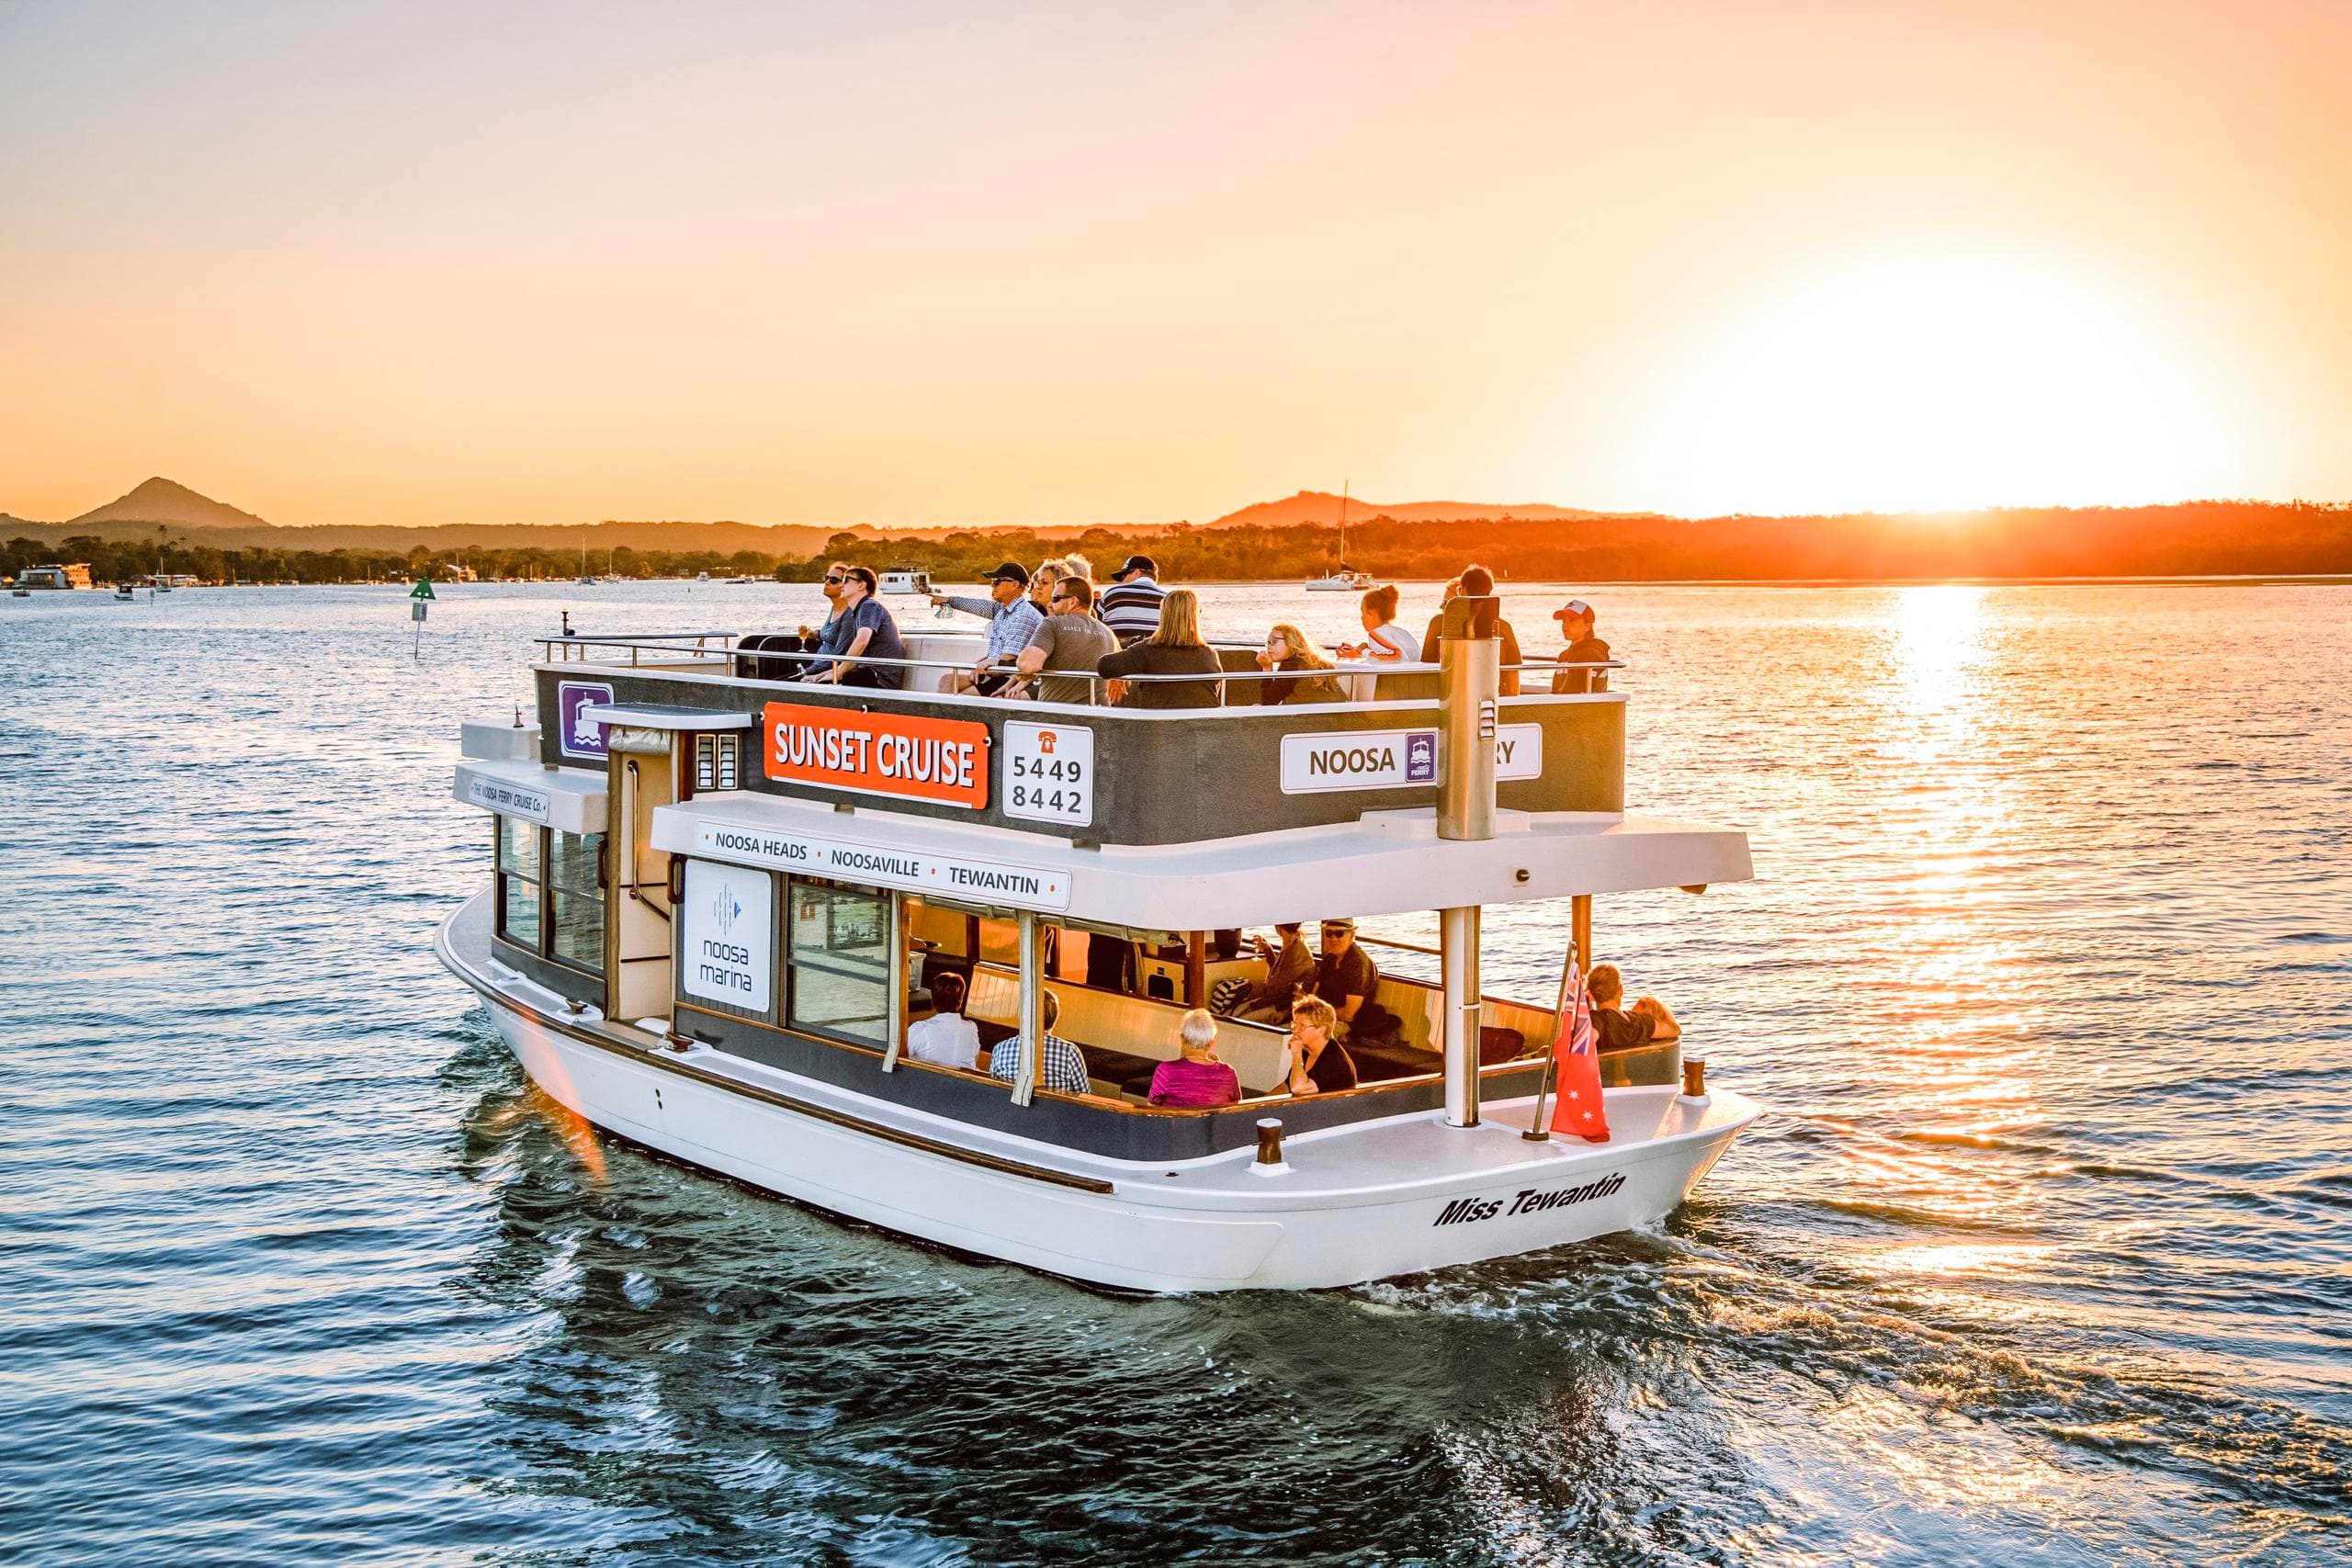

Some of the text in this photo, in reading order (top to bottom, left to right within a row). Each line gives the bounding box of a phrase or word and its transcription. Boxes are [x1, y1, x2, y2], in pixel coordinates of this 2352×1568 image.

[775, 722, 976, 787] SUNSET CRUISE
[1309, 747, 1396, 774] NOOSA
[1012, 756, 1081, 783] 5449
[482, 785, 497, 800] NOOSA
[498, 789, 514, 805] FERRY
[514, 794, 533, 810] CRUISE
[1012, 785, 1081, 814] 8442
[715, 832, 1040, 895] NOOSA HEADS NOOSAVILLE TEWANTIN
[704, 939, 749, 965] noosa
[700, 962, 752, 992] marina
[1432, 1172, 1627, 1226] Miss Tewantin
